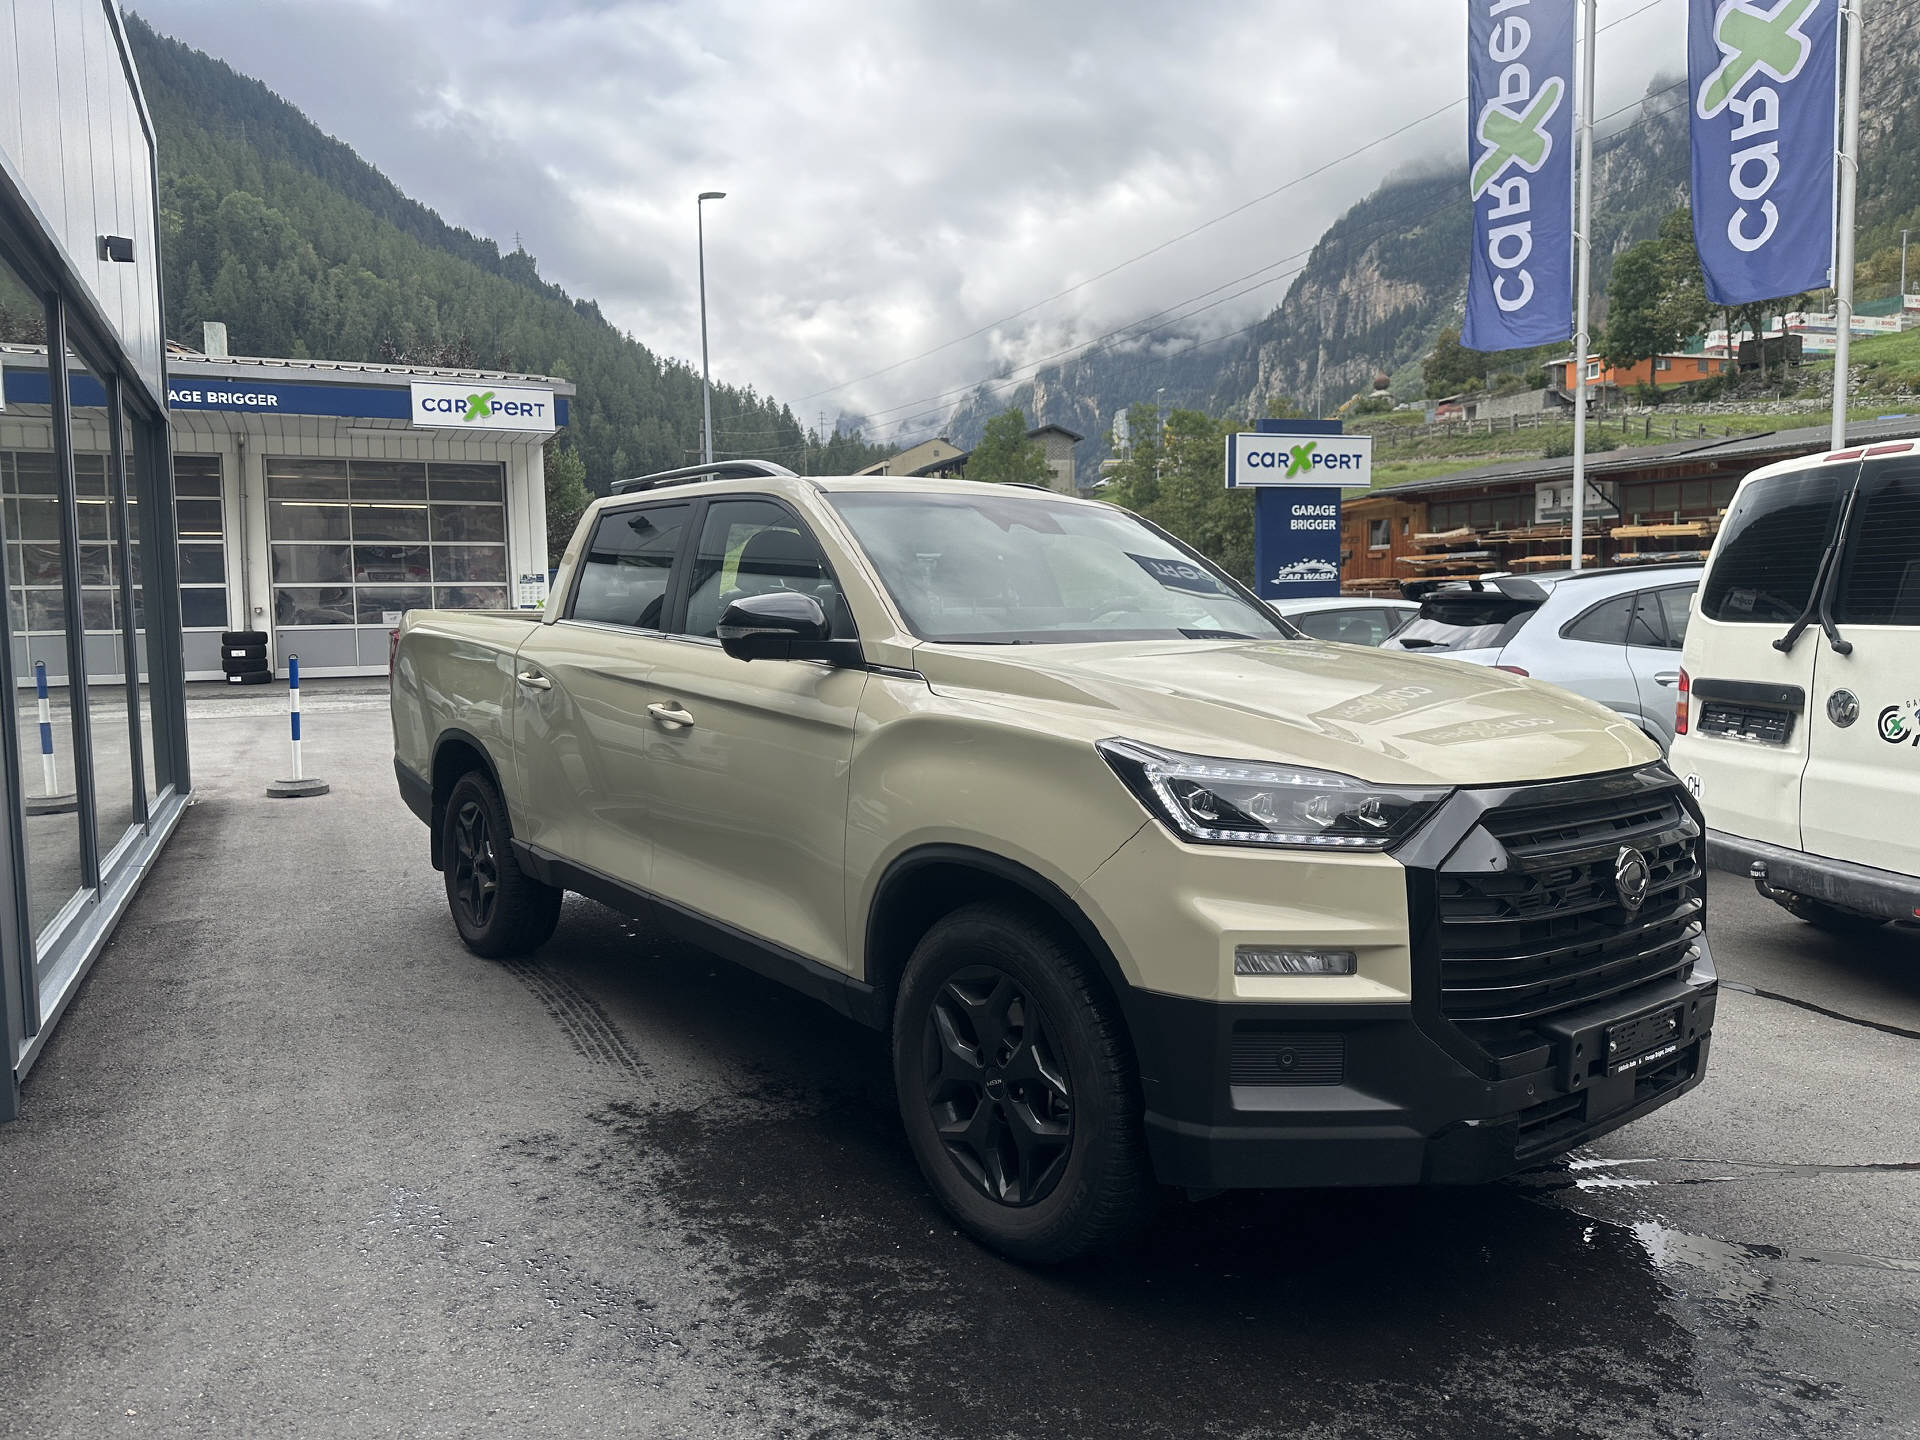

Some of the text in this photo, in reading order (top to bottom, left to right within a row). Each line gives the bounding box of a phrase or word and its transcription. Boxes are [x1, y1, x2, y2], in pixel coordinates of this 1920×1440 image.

[168, 389, 279, 406] AGE BRIGGER
[1291, 505, 1336, 516] GARAGE
[1290, 519, 1336, 530] BRIGGER
[1278, 572, 1336, 580] CAR WASH
[1687, 776, 1701, 797] CH
